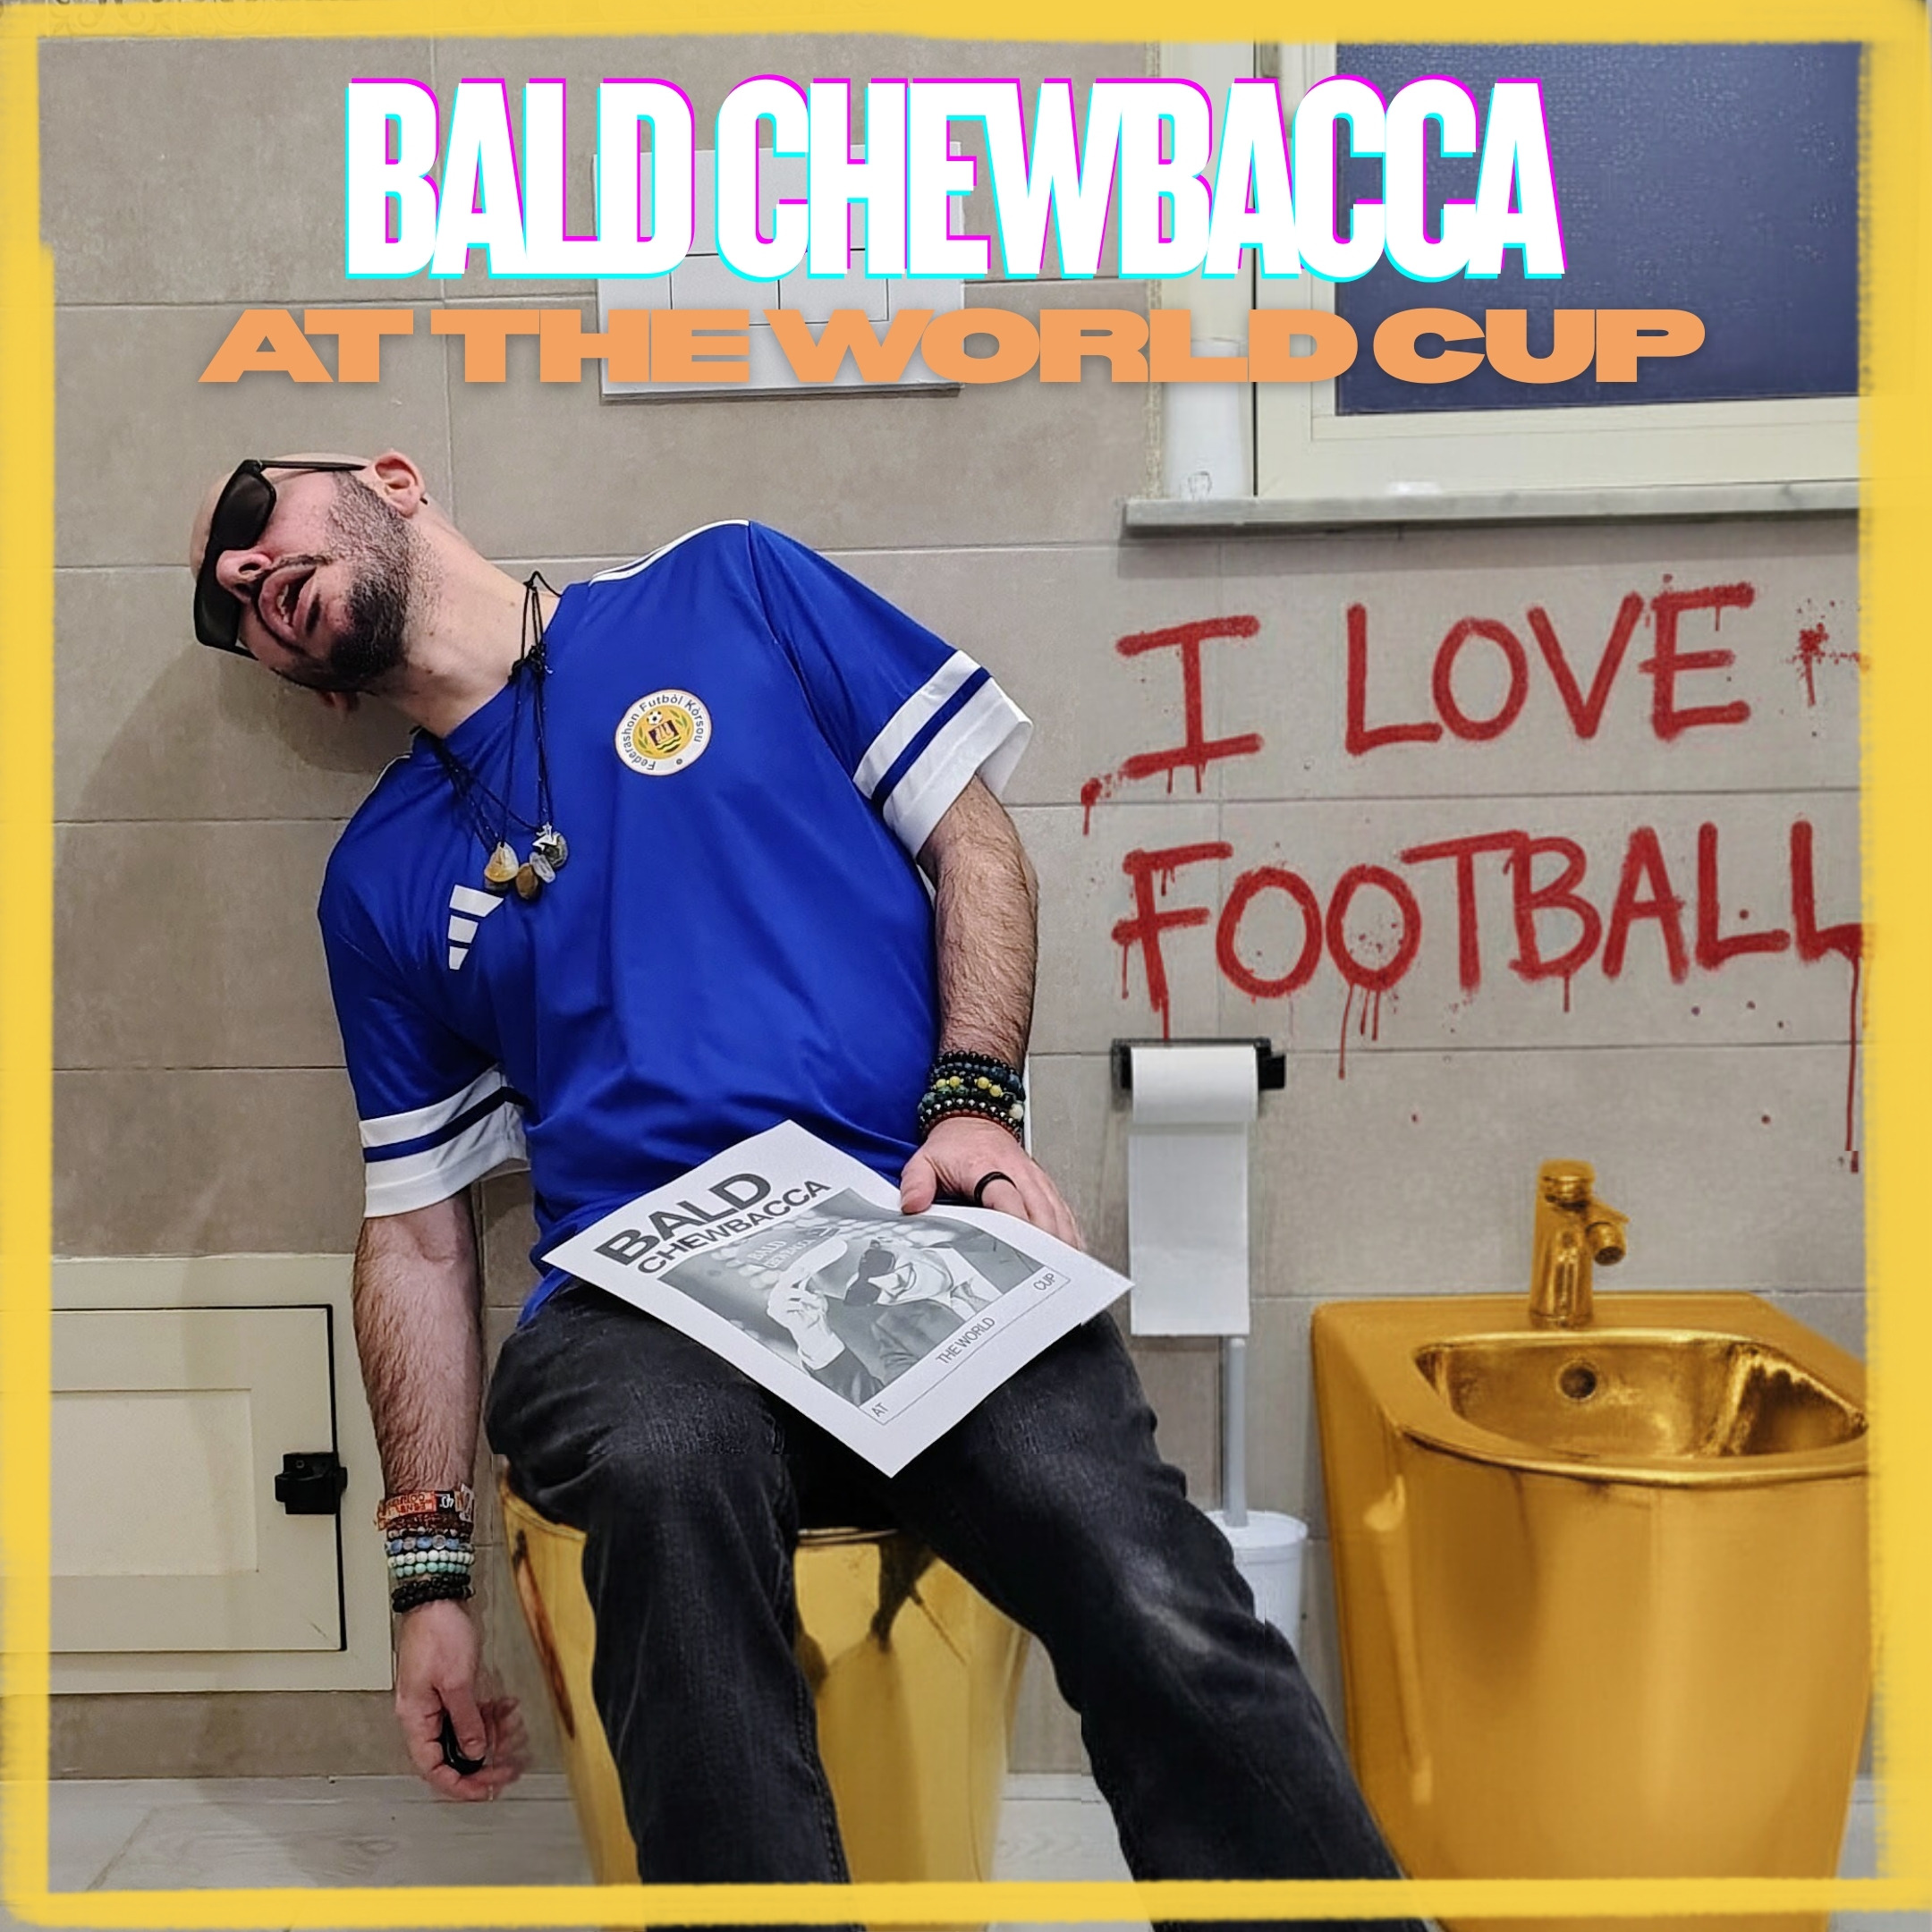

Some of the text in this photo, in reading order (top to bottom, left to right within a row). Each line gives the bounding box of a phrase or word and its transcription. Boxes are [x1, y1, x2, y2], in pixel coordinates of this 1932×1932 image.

[1115, 582, 1755, 780] I LOVE
[621, 712, 657, 771] Federashon
[1112, 820, 1863, 1011] FOOTBALL
[593, 1173, 771, 1266] BALD
[637, 1180, 832, 1274] CHEWBACCA
[871, 1273, 1056, 1418] AT THE WORLD CUP
